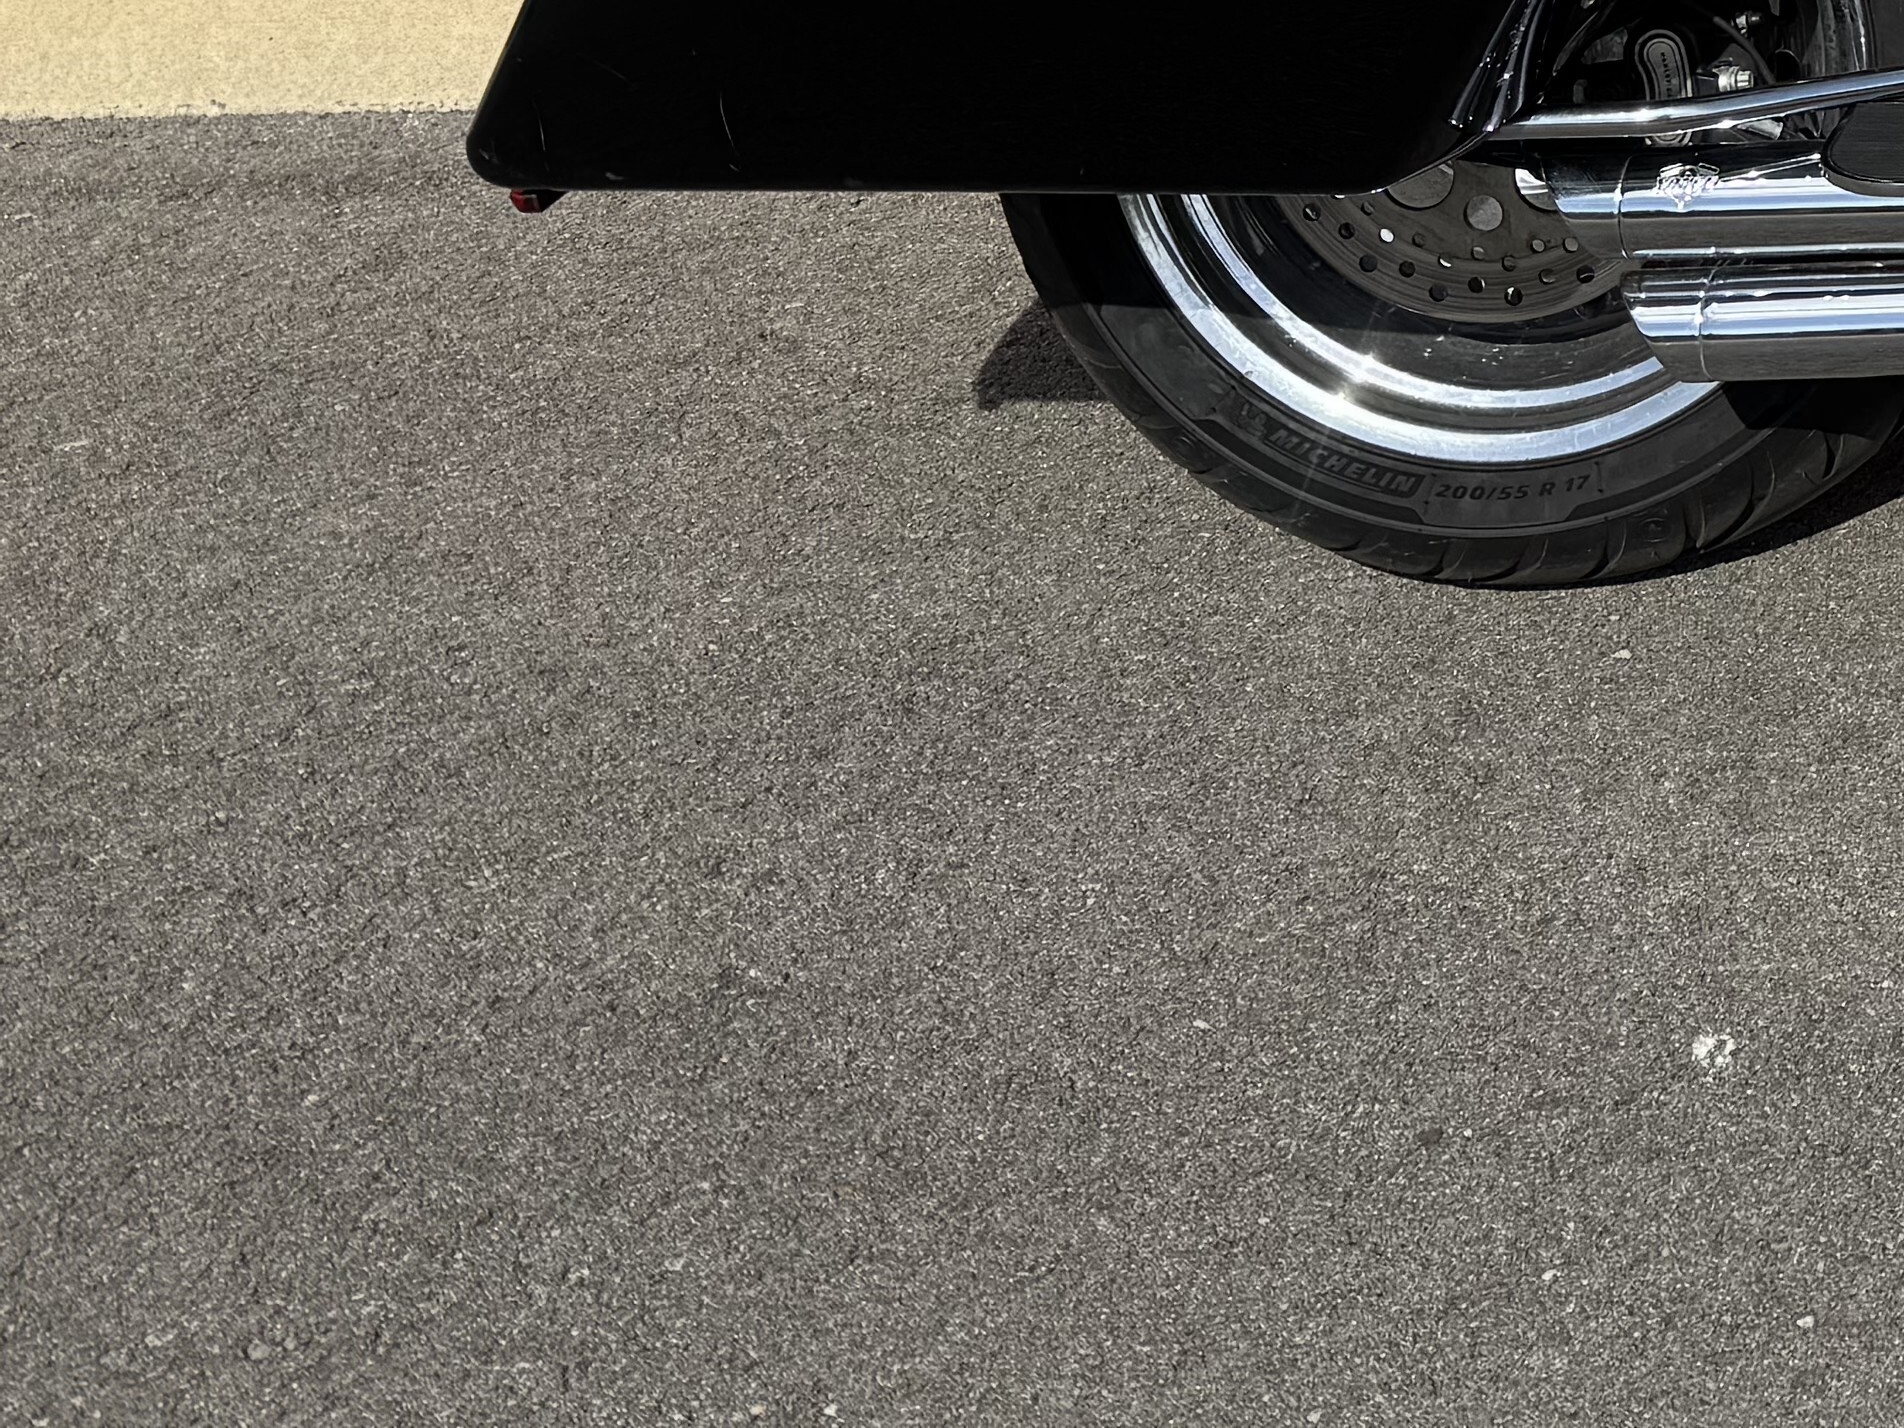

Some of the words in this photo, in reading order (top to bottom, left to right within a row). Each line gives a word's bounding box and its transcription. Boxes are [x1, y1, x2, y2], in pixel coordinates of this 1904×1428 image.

[1269, 430, 1415, 495] MICHELIN
[1435, 482, 1530, 501] 200/55
[1539, 481, 1557, 496] R
[1565, 474, 1591, 493] 17
